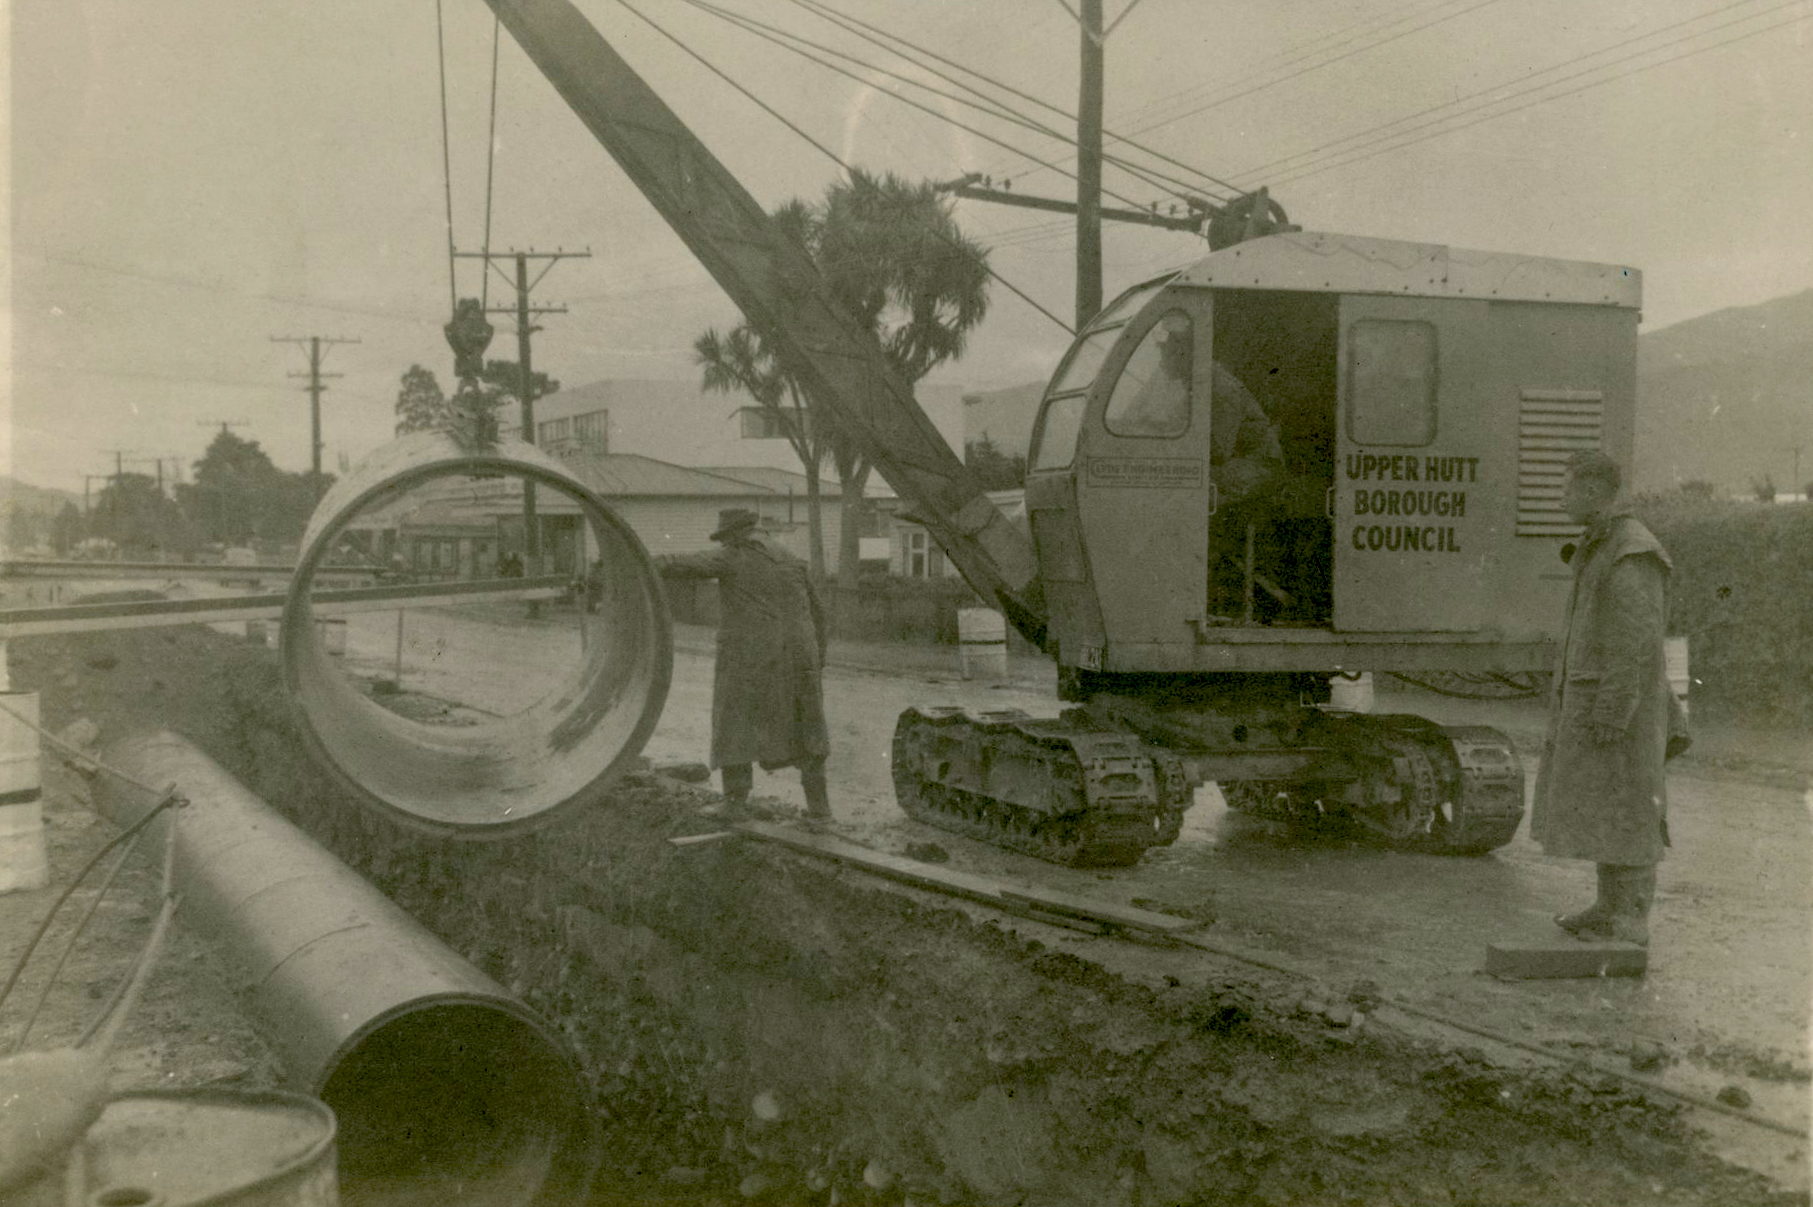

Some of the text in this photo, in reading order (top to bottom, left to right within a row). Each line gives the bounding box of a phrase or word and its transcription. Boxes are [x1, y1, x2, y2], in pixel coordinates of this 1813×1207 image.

[1346, 454, 1480, 482] UPPER HUTT
[1354, 489, 1466, 517] BOROUGH
[1352, 525, 1461, 552] COUNCIL
